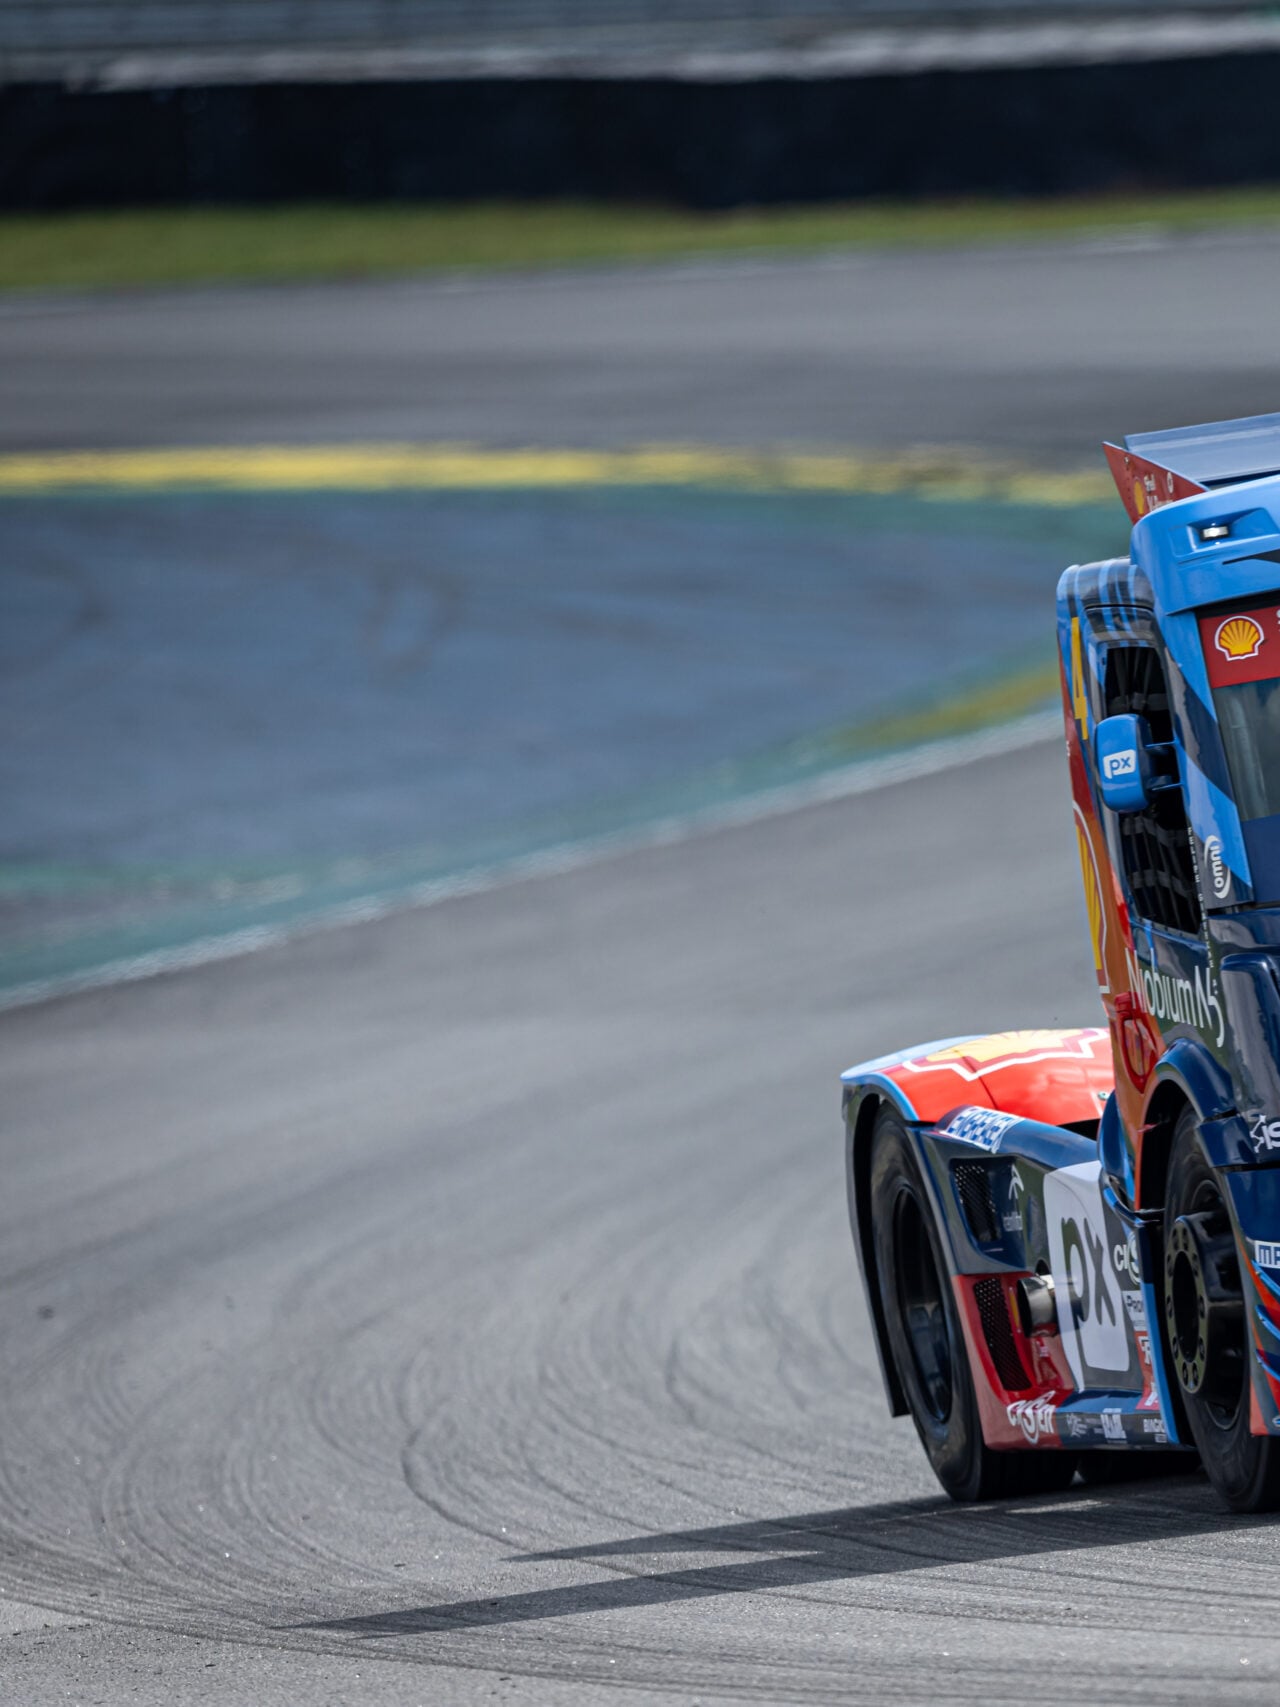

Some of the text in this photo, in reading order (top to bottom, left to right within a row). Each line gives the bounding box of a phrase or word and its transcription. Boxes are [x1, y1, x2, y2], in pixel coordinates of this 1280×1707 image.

[1071, 616, 1089, 740] 4
[1109, 756, 1132, 777] px
[1209, 845, 1225, 888] omni
